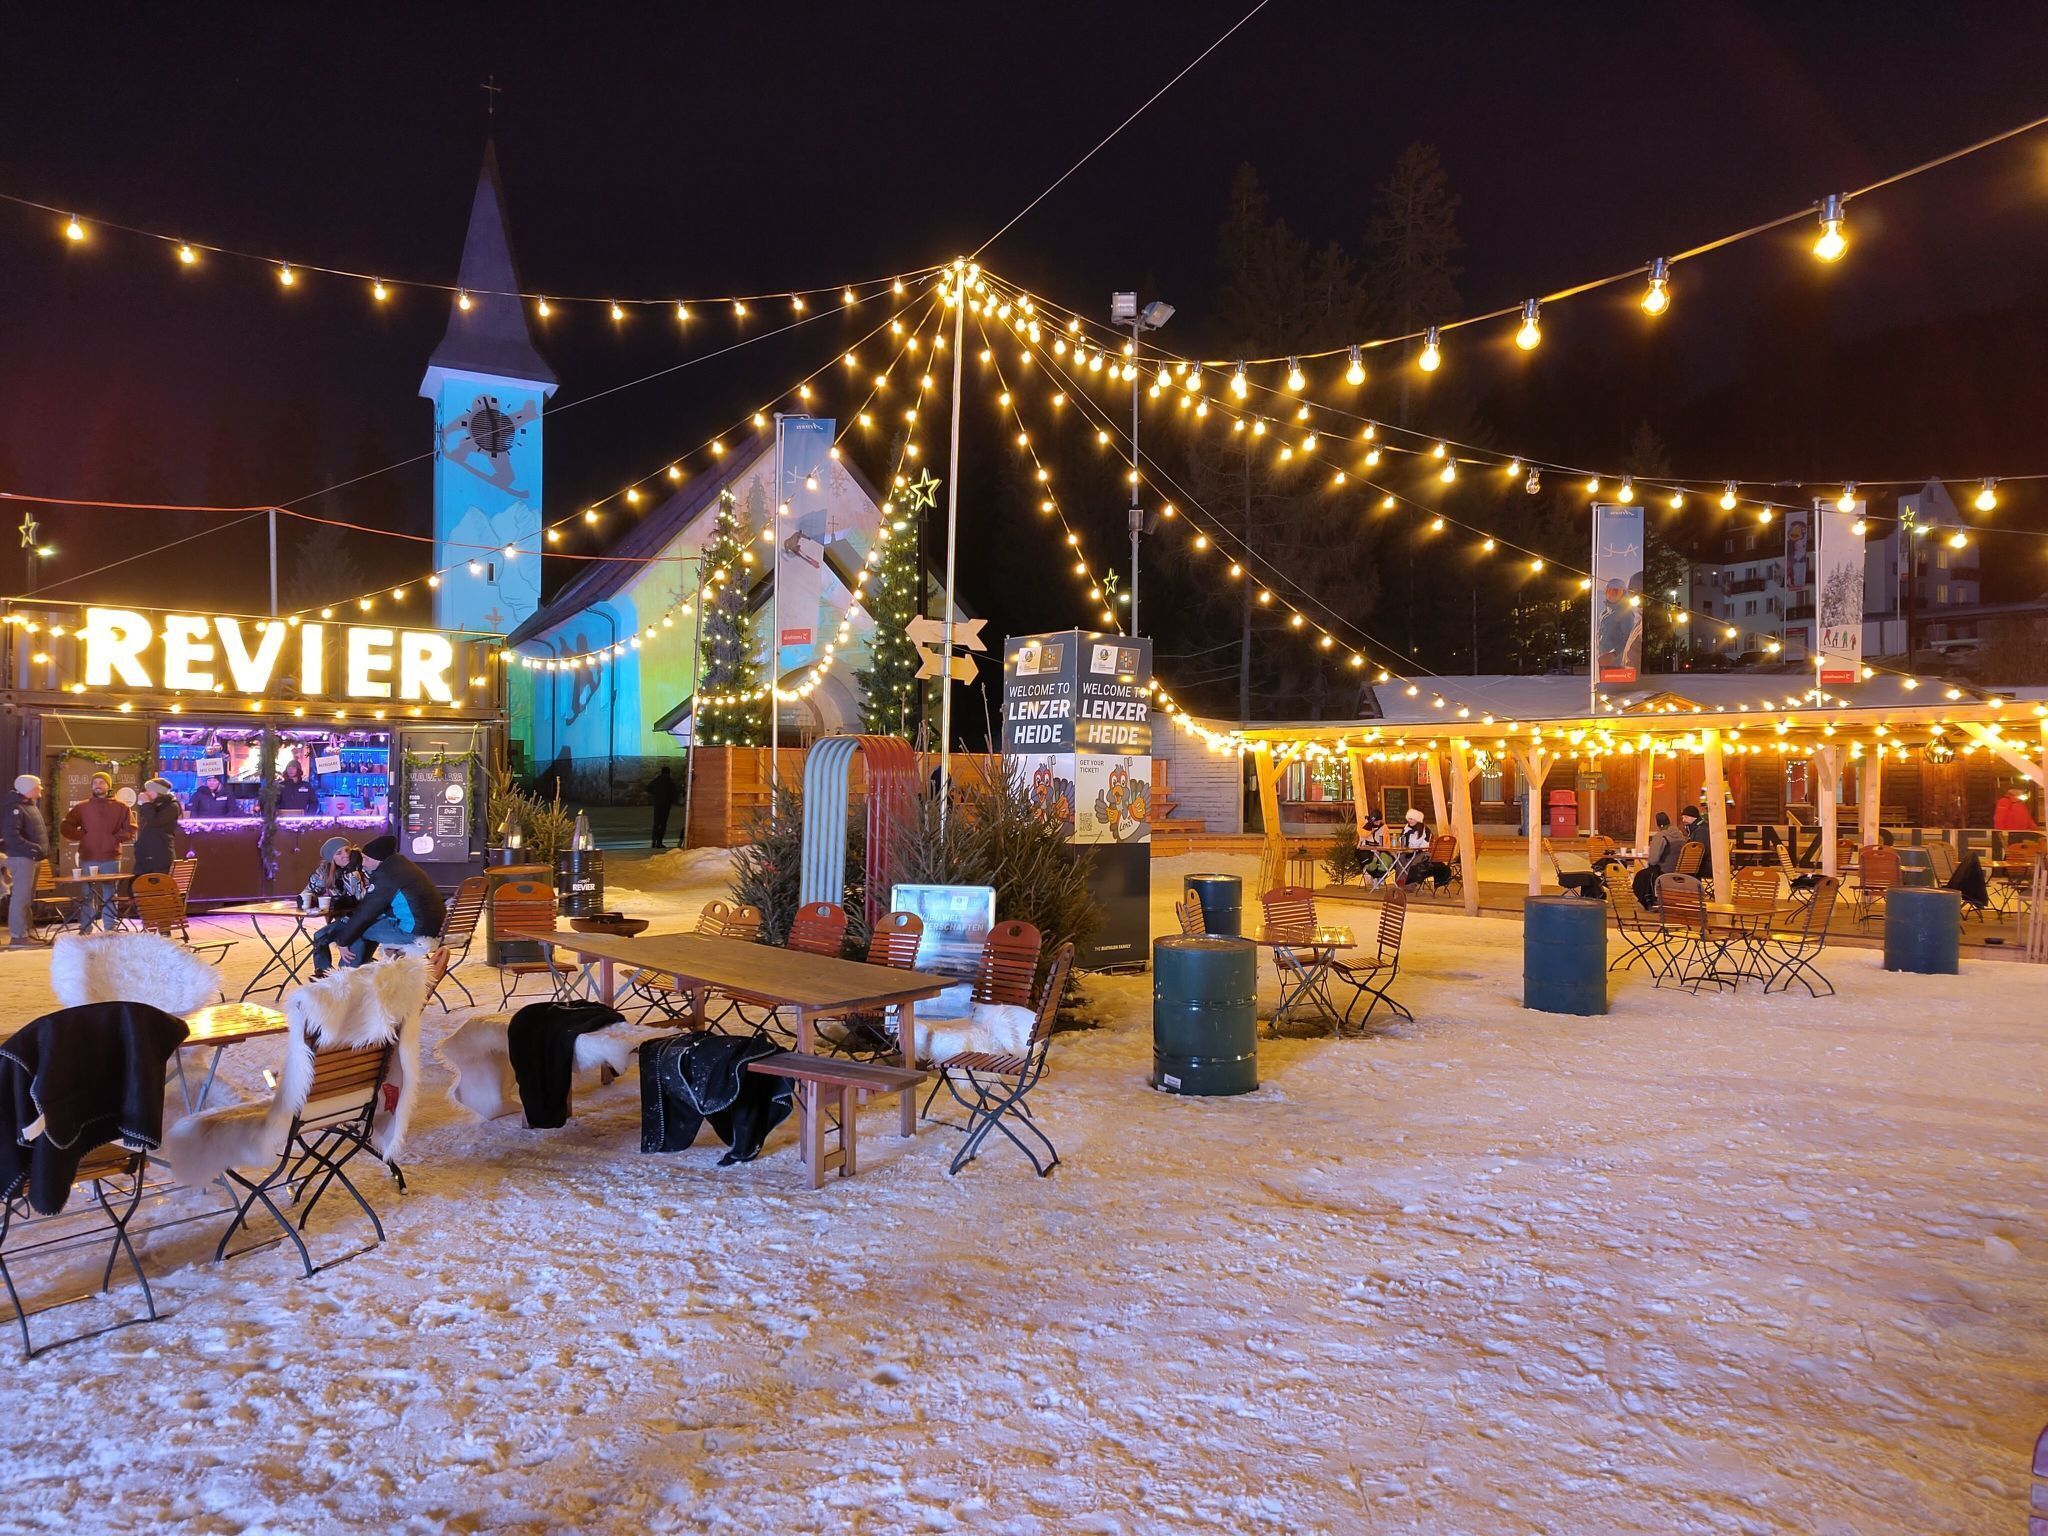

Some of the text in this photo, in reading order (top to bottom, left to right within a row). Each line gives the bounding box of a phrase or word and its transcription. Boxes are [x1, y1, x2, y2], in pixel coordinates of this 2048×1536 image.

[85, 607, 453, 702] REVIER
[1009, 682, 1070, 697] WELCOME TO
[1082, 682, 1147, 699] WELCOME TO
[1008, 699, 1071, 720] LENZER
[1081, 699, 1147, 721] LENZER
[1014, 724, 1063, 744] HEIDE
[1088, 724, 1140, 745] HEIDE
[573, 883, 595, 891] REVIER
